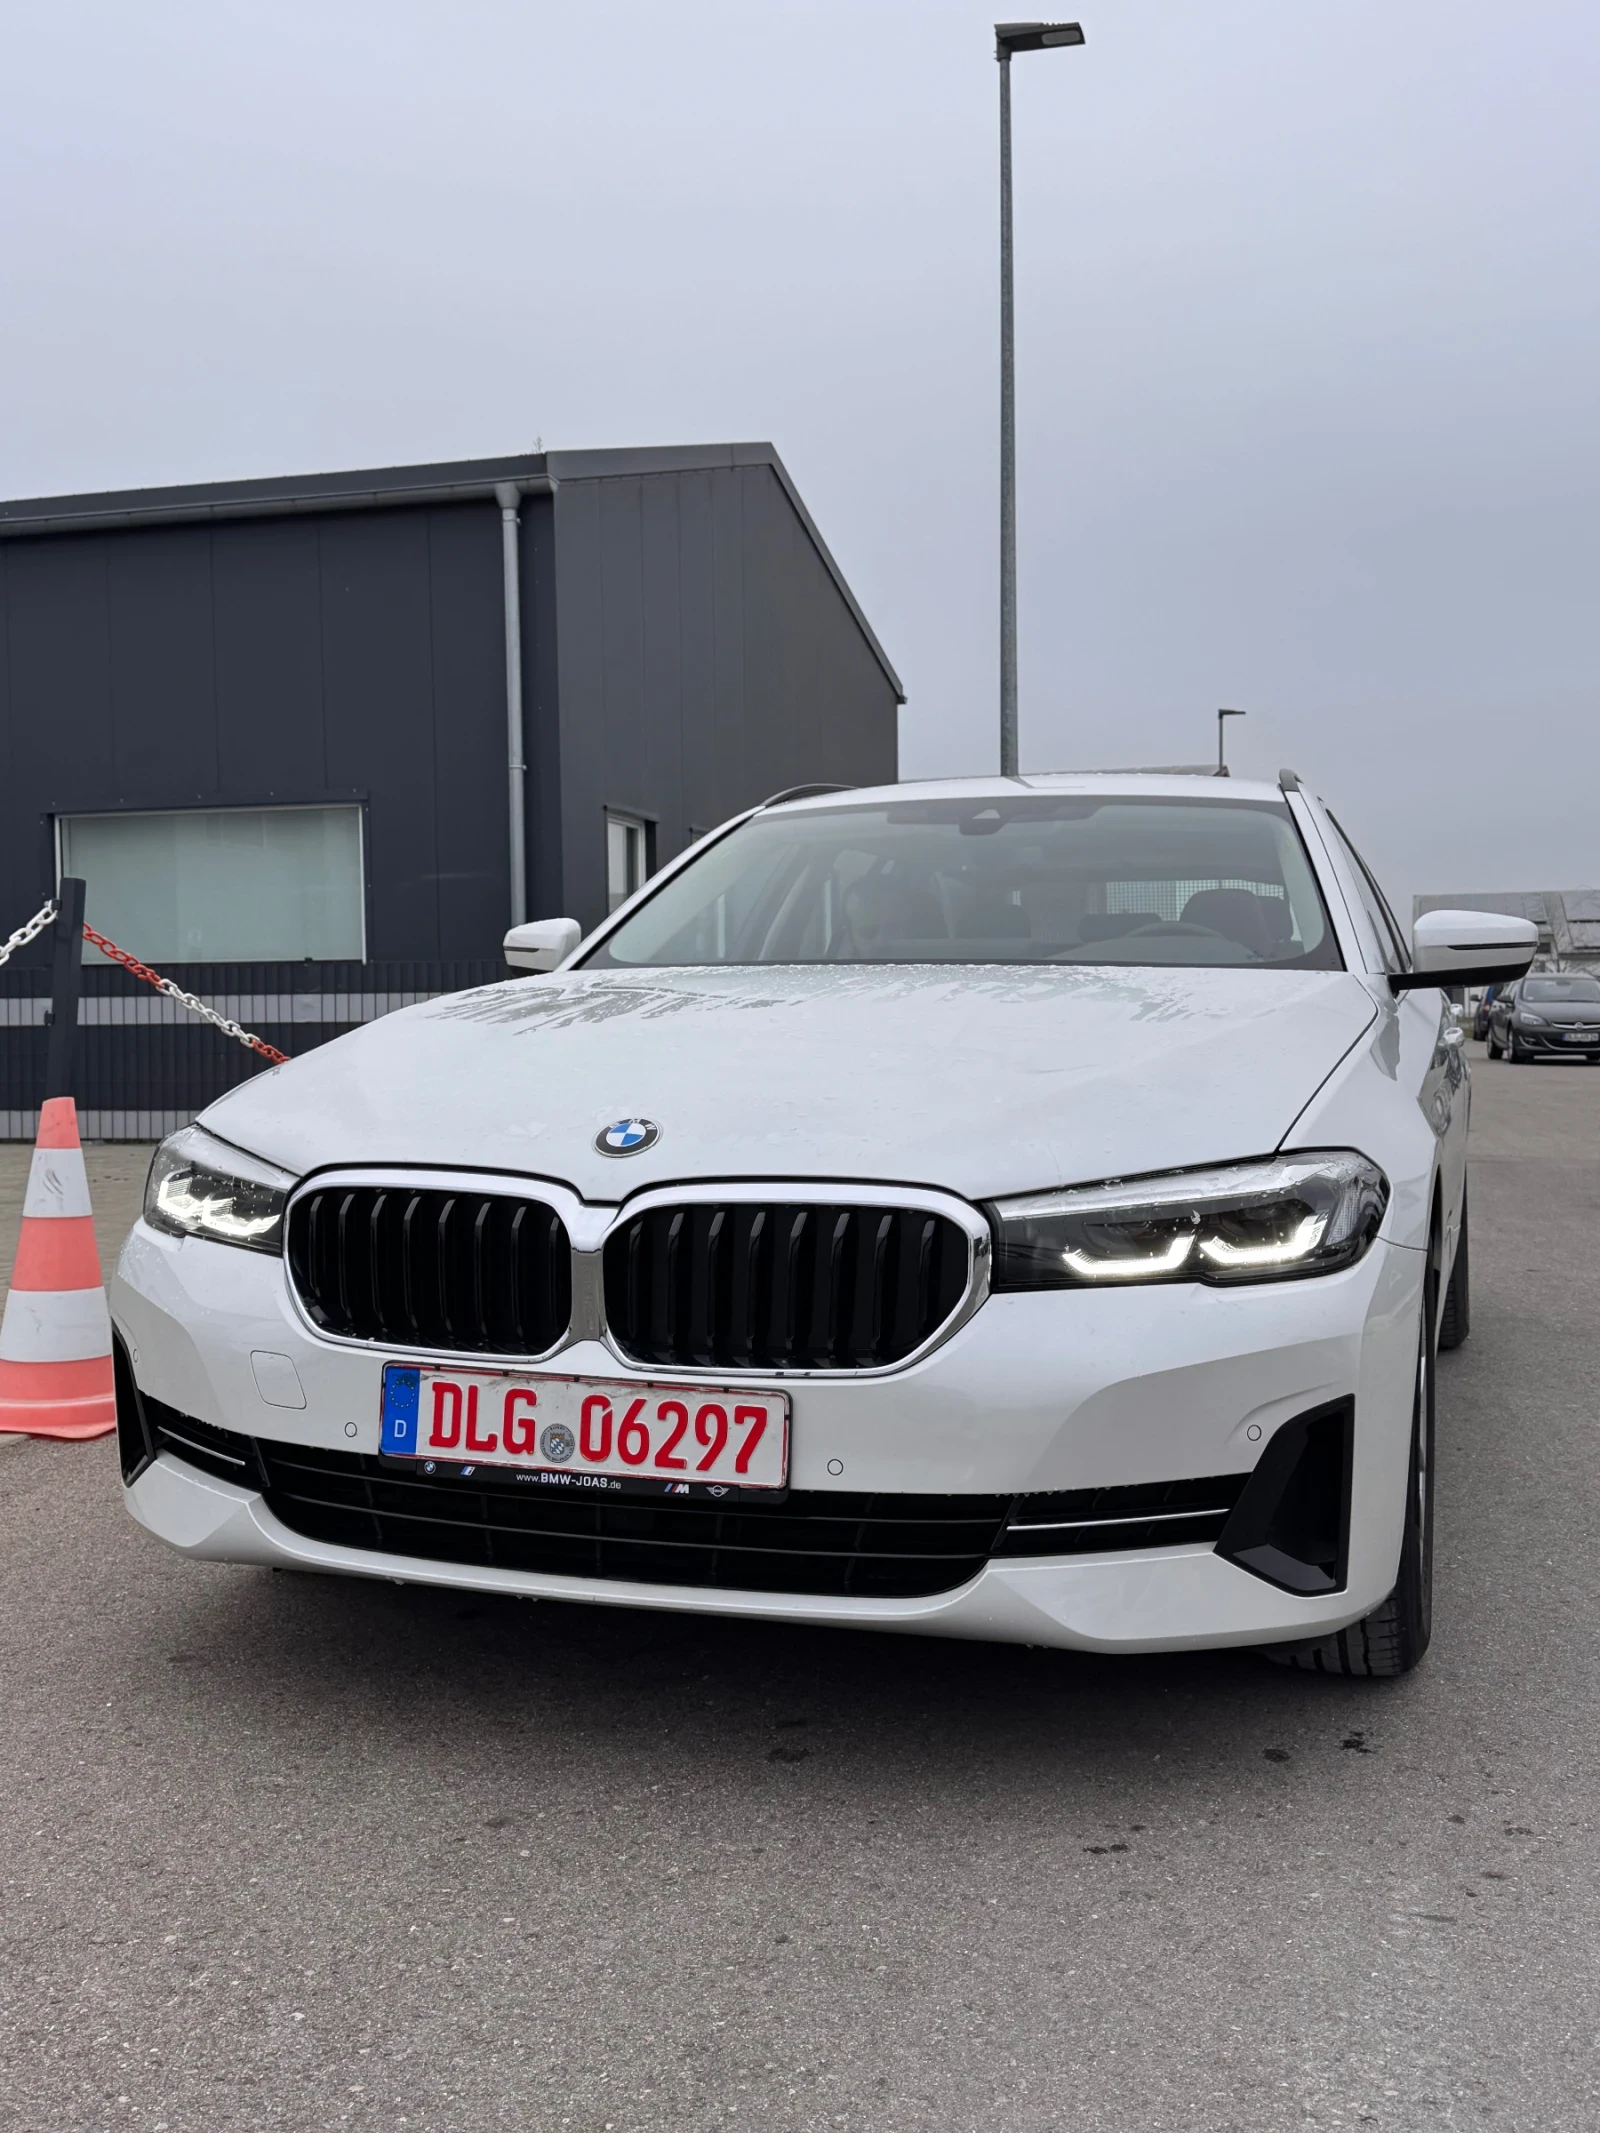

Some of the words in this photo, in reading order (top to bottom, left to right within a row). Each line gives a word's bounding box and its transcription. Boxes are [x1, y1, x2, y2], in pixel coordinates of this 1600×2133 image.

[394, 1419, 407, 1438] D
[429, 1381, 537, 1455] DLG
[579, 1394, 768, 1474] 06297
[516, 1472, 621, 1489] www.BMW-JOAS.de
